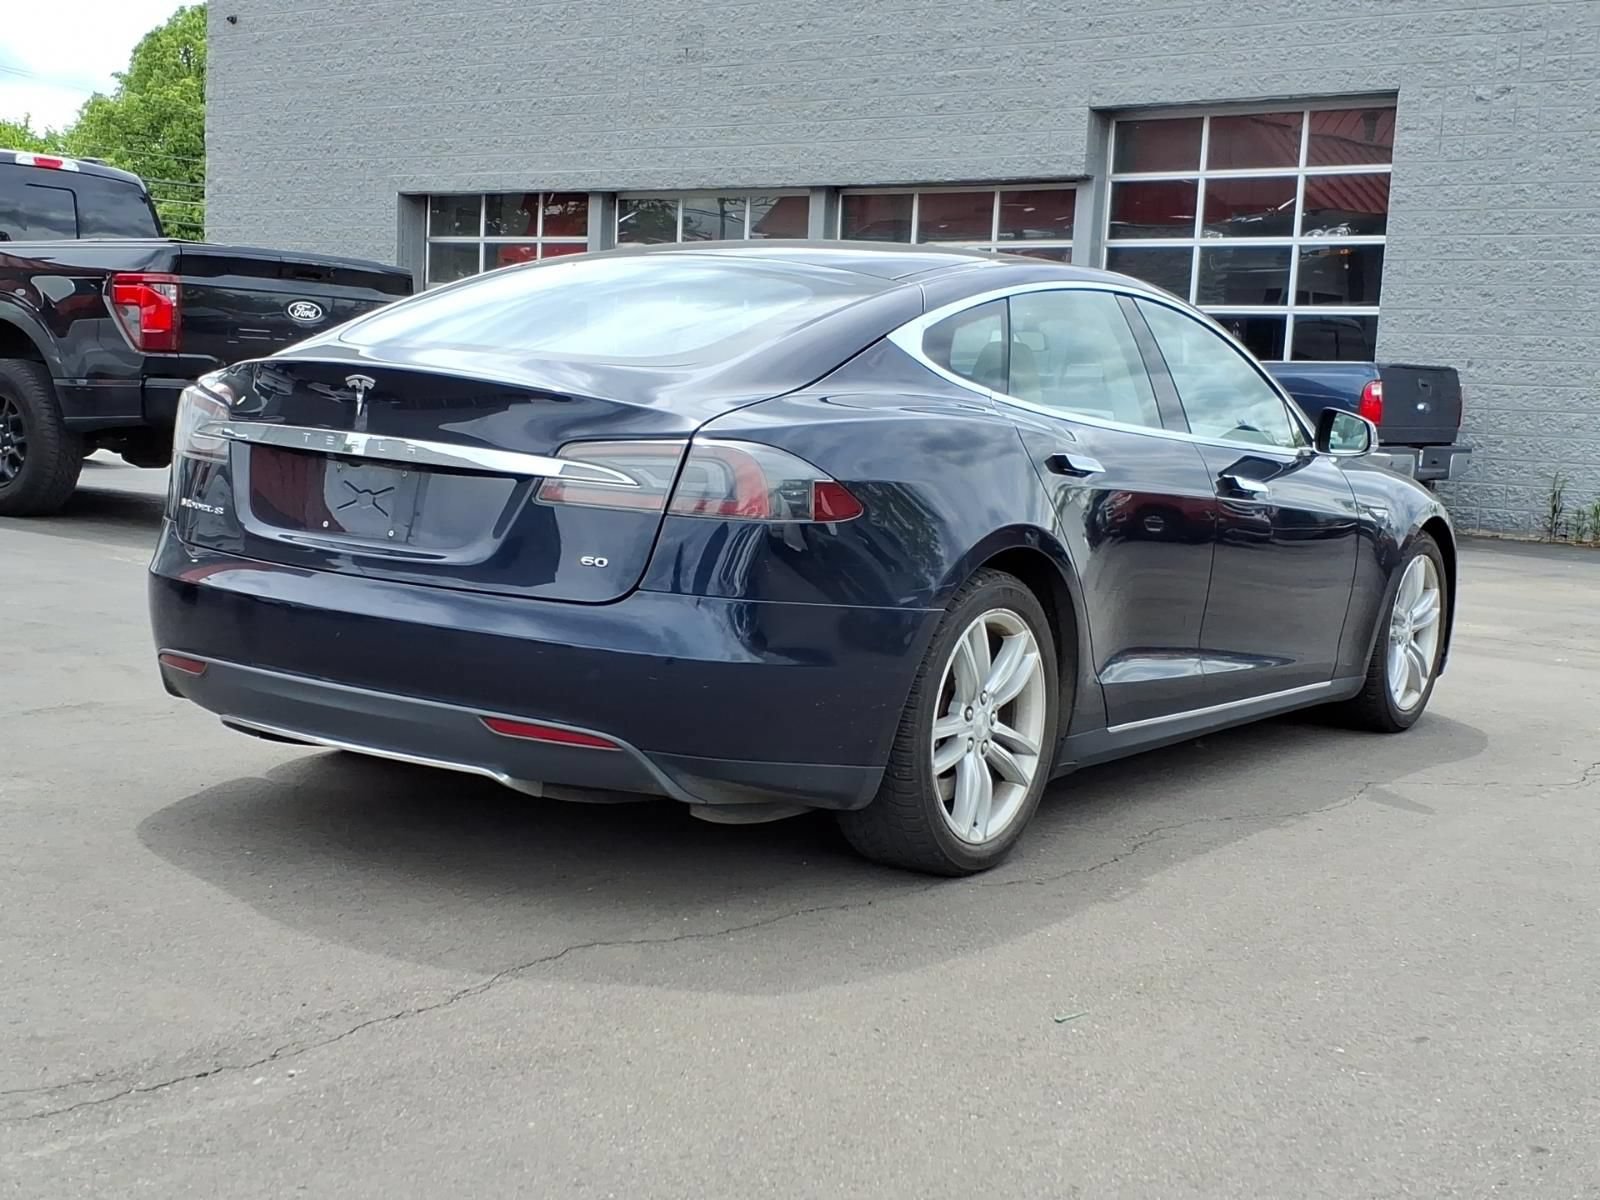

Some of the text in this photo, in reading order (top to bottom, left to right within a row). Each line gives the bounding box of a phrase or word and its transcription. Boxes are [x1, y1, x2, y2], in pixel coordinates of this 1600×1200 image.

[292, 303, 318, 319] Ford
[303, 432, 416, 454] TESLA
[214, 506, 224, 515] S
[580, 555, 608, 568] 60
